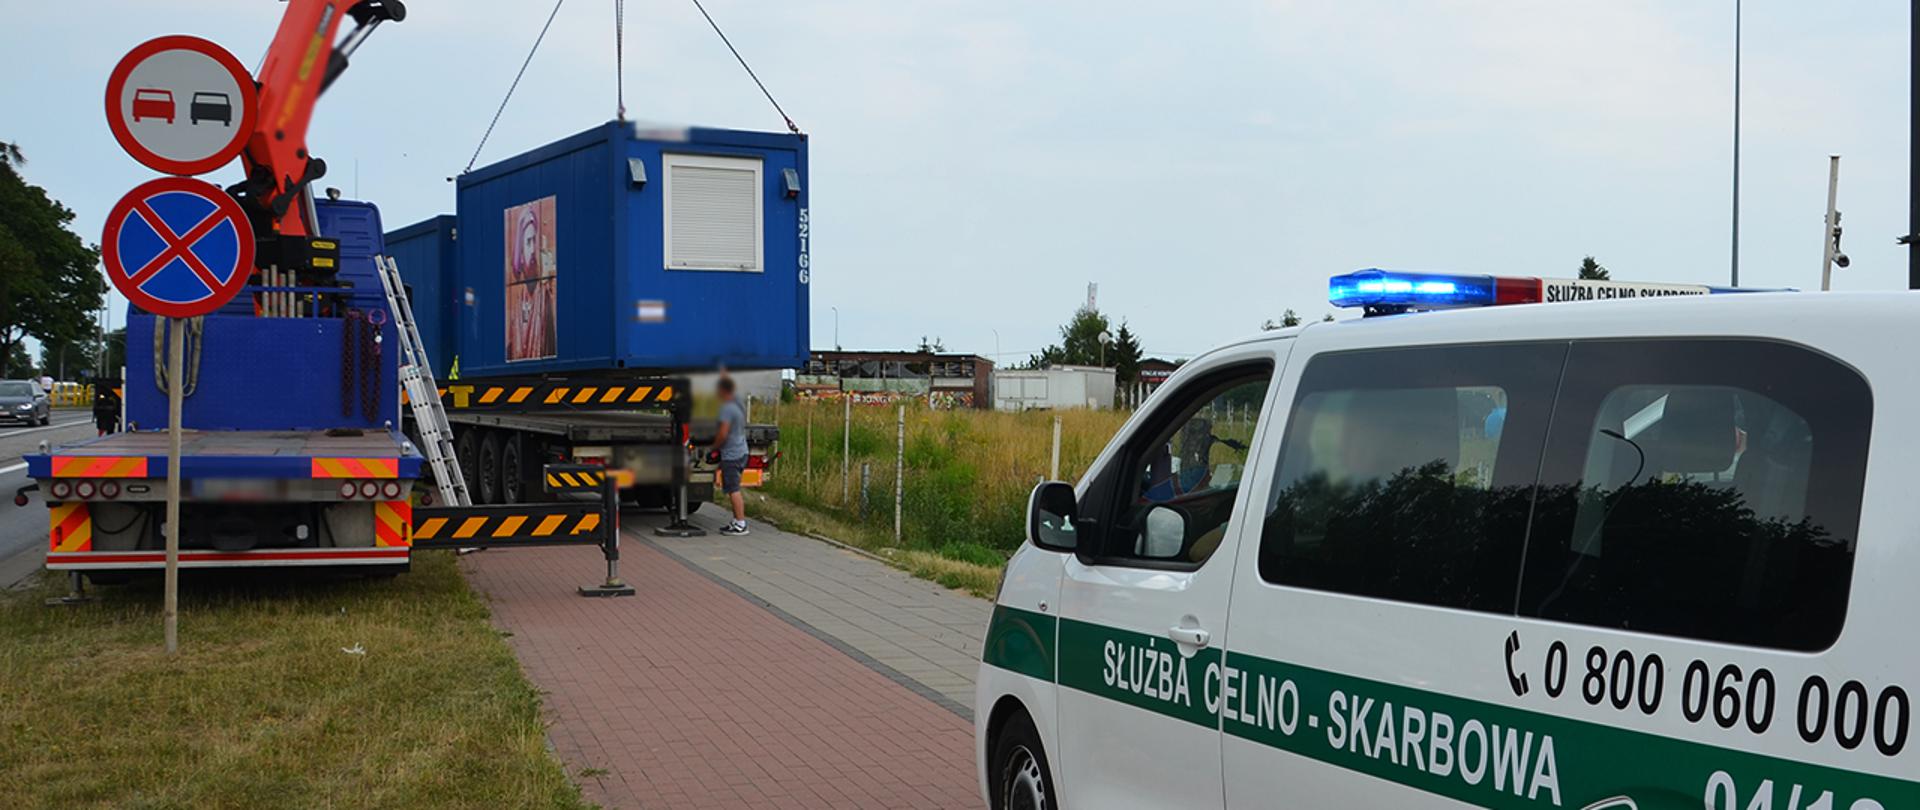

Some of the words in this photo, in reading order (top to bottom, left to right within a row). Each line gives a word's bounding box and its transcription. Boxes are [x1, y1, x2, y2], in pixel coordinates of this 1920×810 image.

[798, 208, 809, 284] 52166
[1547, 282, 1593, 302] SŁUŻBA
[1103, 637, 1191, 707] SŁUŻBA
[1204, 662, 1299, 736] CELNO
[1327, 690, 1562, 807] SKARBOWA
[1544, 640, 1568, 698] 0
[1582, 646, 1665, 715] 800
[1682, 659, 1776, 735] 060
[1796, 675, 1910, 757] 000
